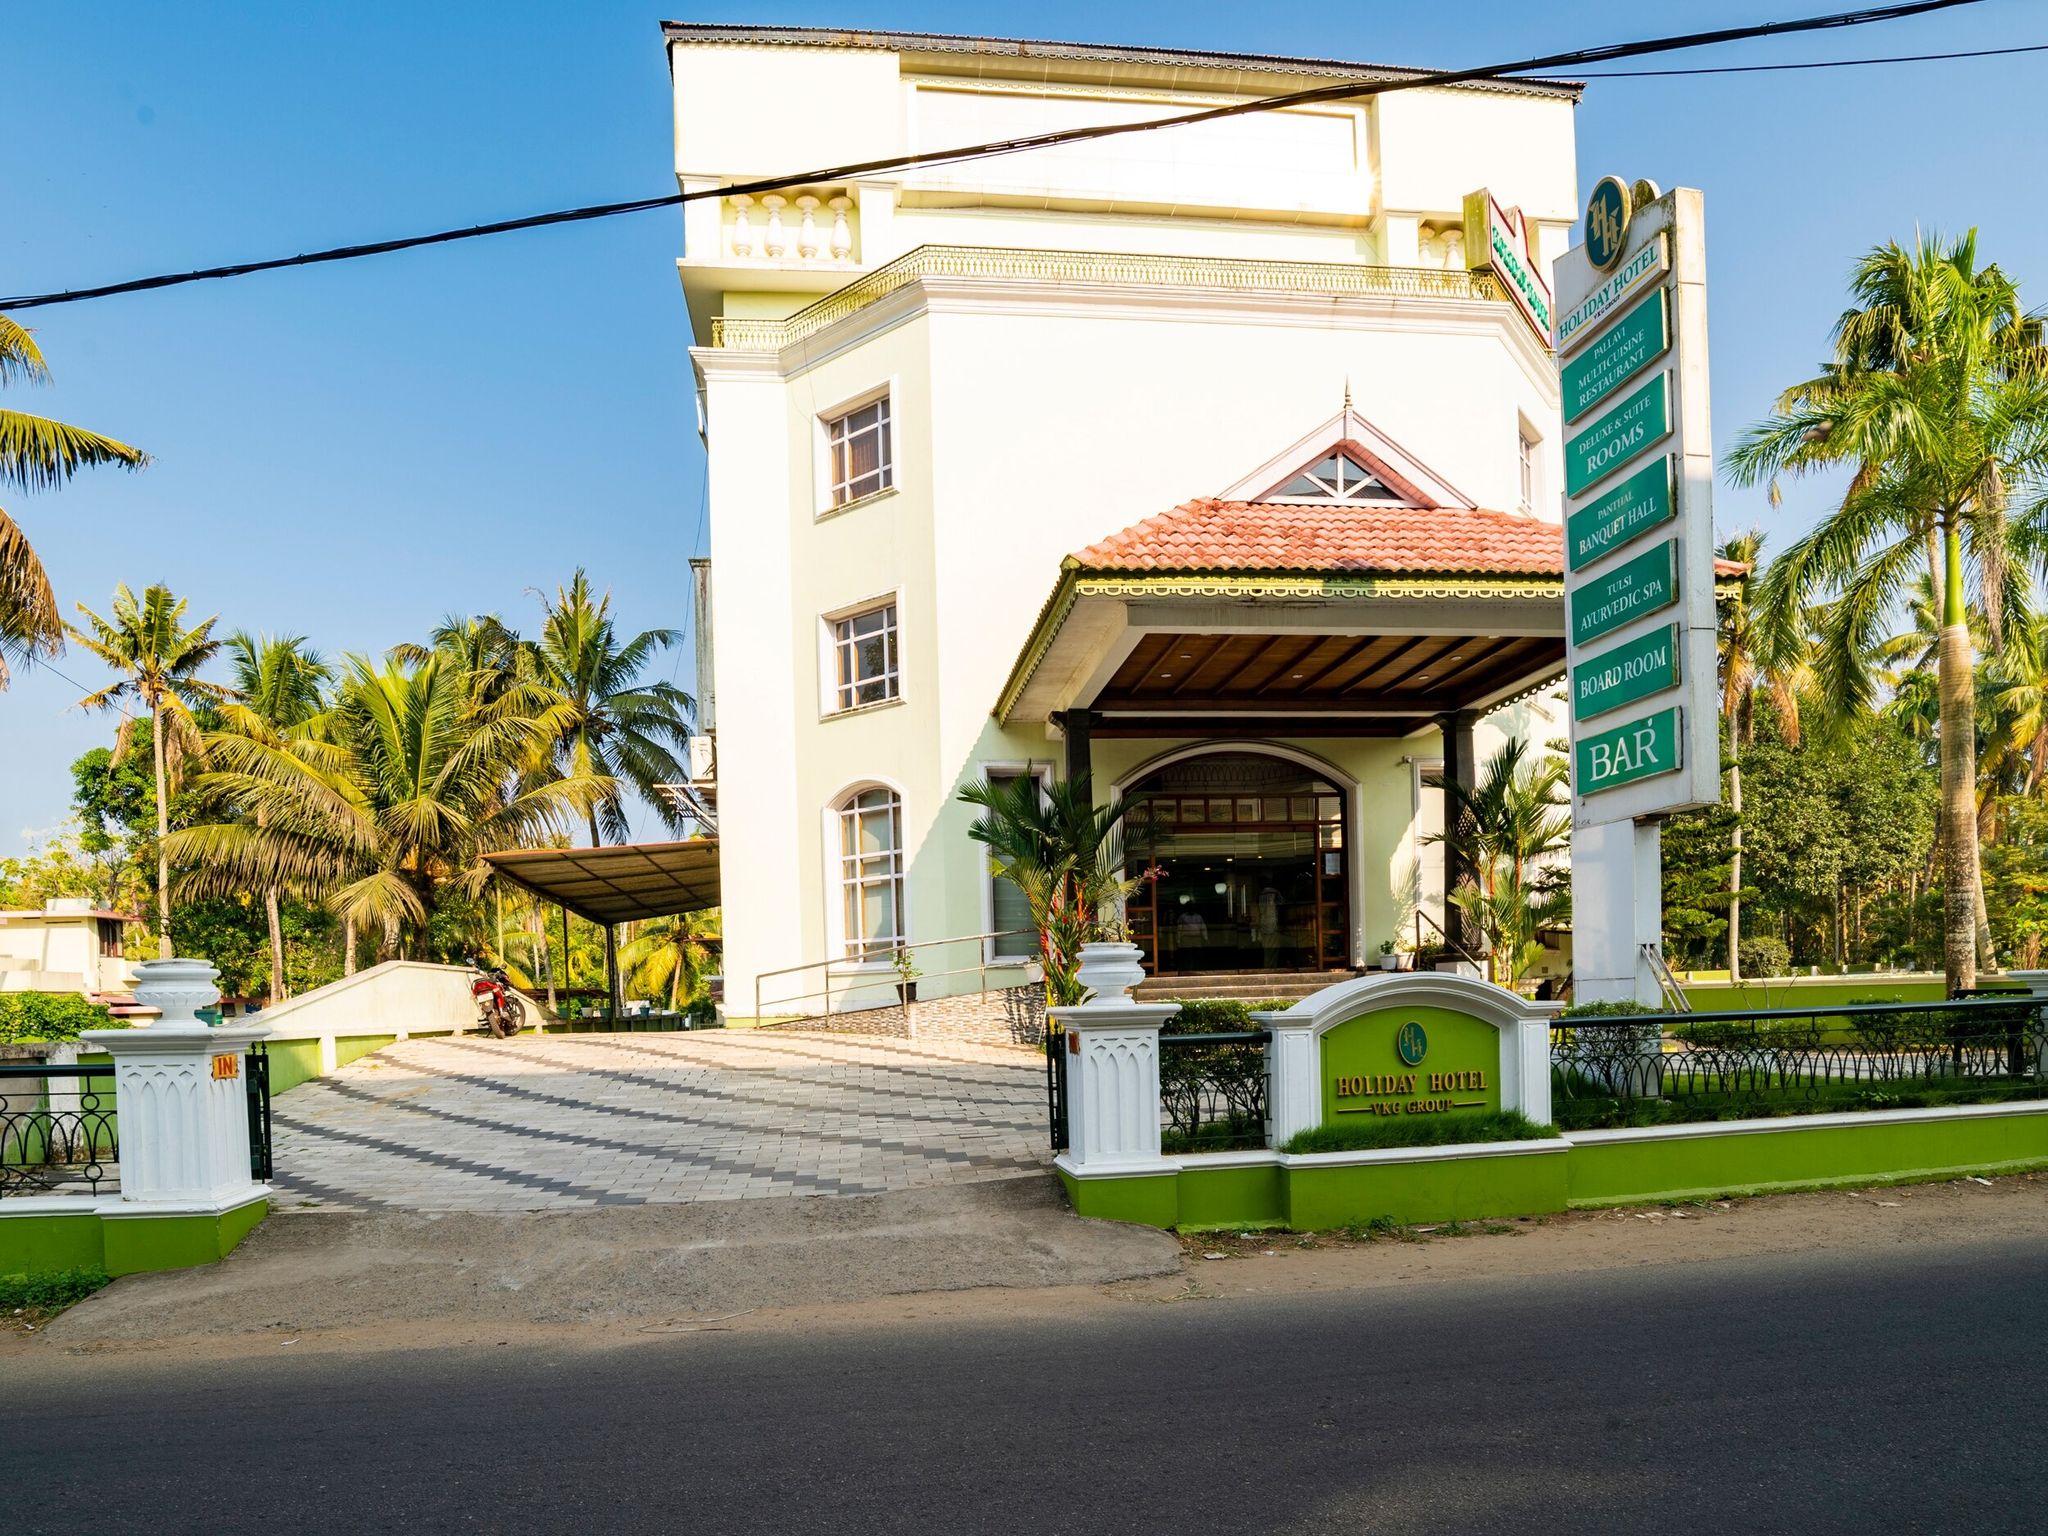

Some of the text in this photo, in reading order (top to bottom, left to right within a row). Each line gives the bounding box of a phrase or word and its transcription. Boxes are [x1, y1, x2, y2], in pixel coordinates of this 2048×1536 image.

[1559, 283, 1612, 340] HOLIDAY
[1613, 246, 1658, 294] HOTEL
[1605, 294, 1620, 311] GROUP
[1578, 328, 1645, 391] MULTICUISINE
[1593, 326, 1626, 360] PALLAVI
[1579, 347, 1645, 407] RESTAURANT
[1579, 395, 1652, 455] DELUXE & SUITE
[1586, 421, 1645, 475] ROOMS
[1579, 496, 1657, 556] BANQUET HALL
[1580, 578, 1663, 632] AYURVEDIC SPA
[1606, 574, 1633, 596] TULSI
[1580, 645, 1667, 699] BOARD ROOM
[1589, 728, 1659, 782] BAR
[217, 1056, 233, 1076] IN
[1337, 1070, 1489, 1096] HOLIDAY HOTEL
[1371, 1099, 1454, 1115] VKG GROUP
